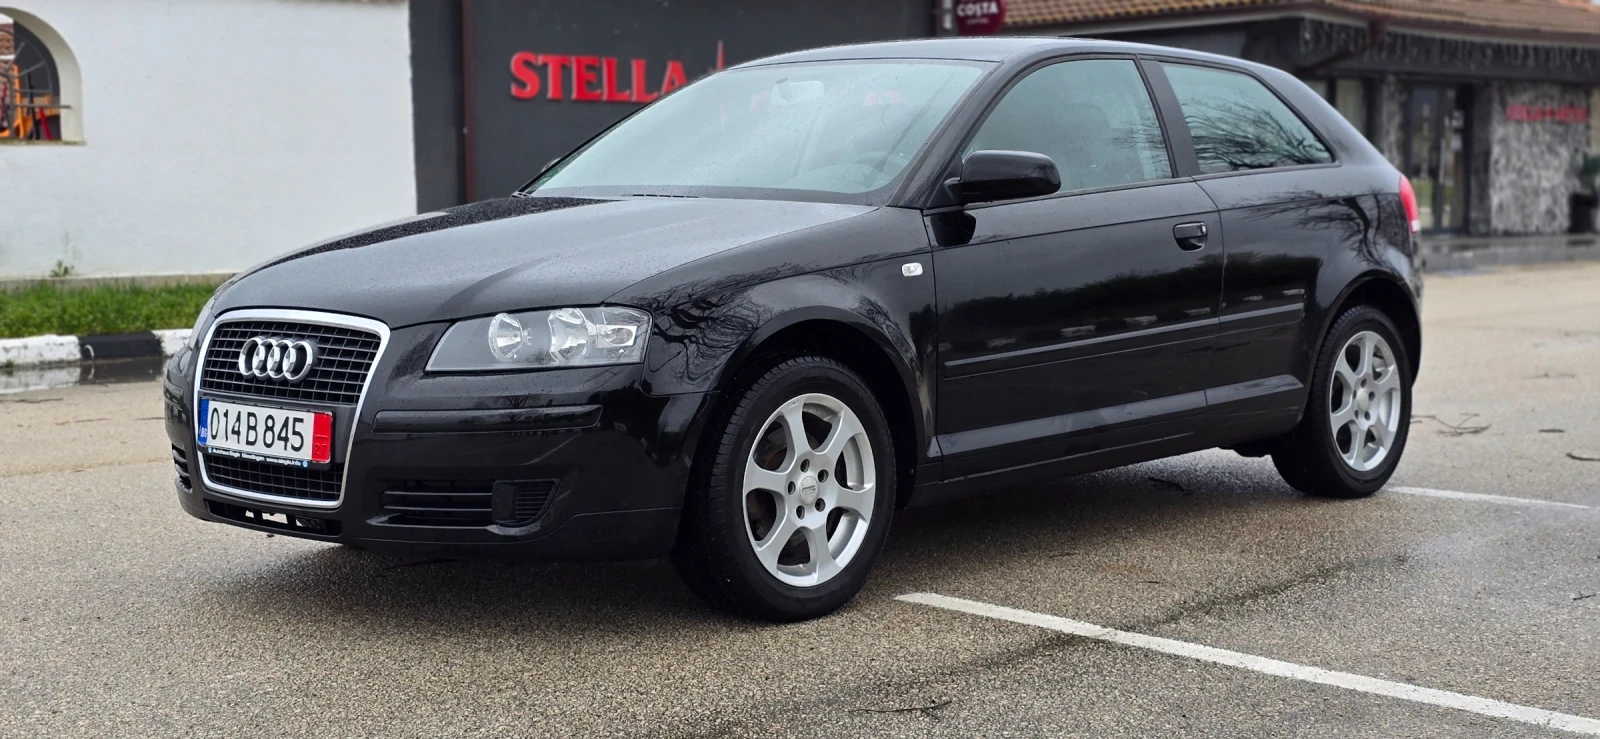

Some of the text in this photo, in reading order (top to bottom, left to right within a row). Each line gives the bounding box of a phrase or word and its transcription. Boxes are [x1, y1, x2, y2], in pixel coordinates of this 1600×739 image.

[956, 1, 999, 17] COSTA
[510, 51, 689, 103] STELLA
[314, 442, 327, 456] 27
